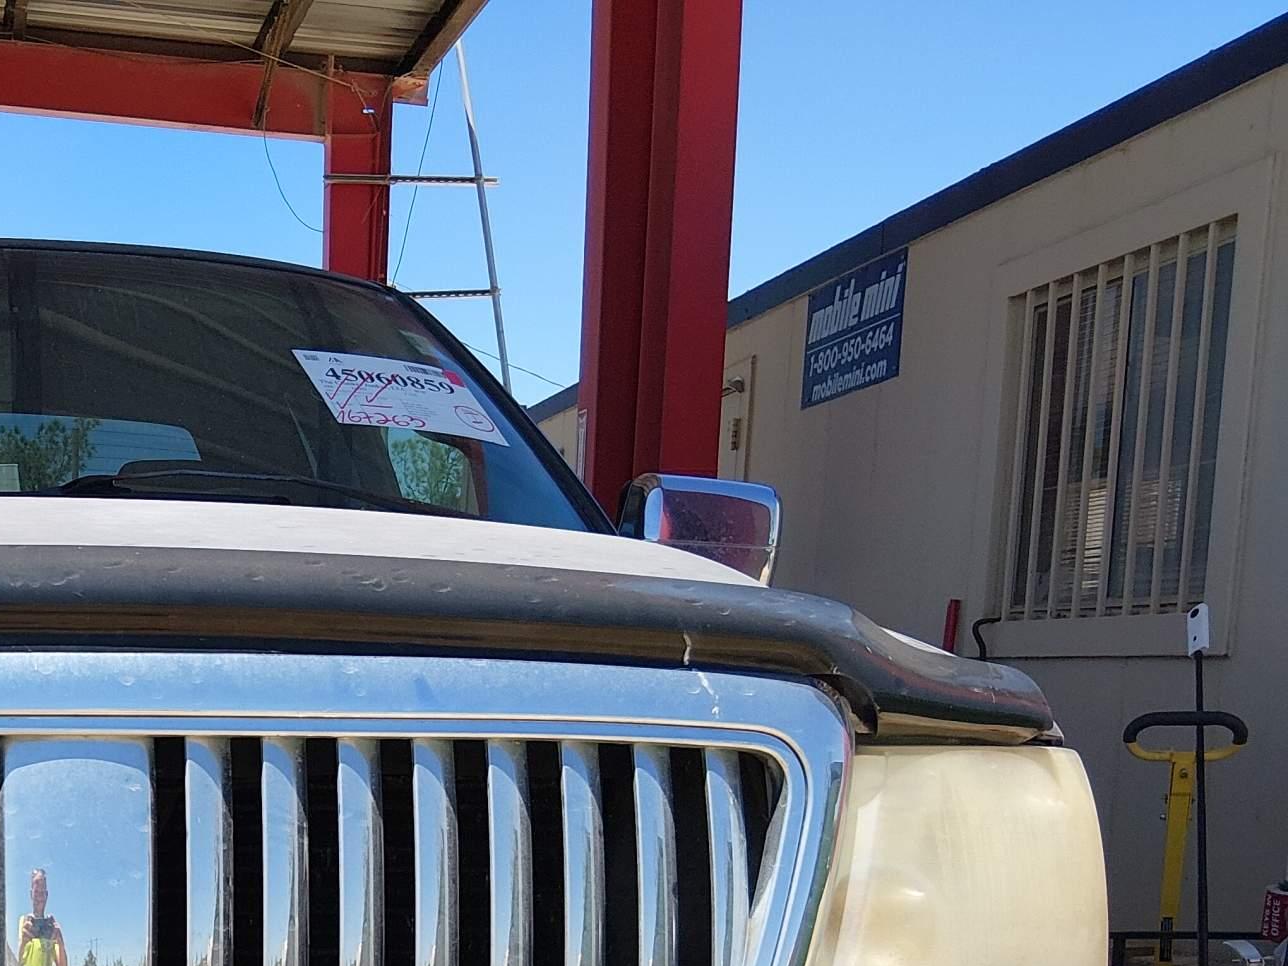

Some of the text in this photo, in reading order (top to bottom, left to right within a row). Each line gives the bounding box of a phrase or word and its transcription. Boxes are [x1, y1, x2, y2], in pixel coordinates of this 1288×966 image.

[808, 263, 904, 345] mobile mini
[809, 322, 894, 376] 1-800-950-6464
[325, 367, 455, 394] 45060859
[812, 360, 887, 400] mobilemini.com
[1271, 899, 1281, 936] OFFICE
